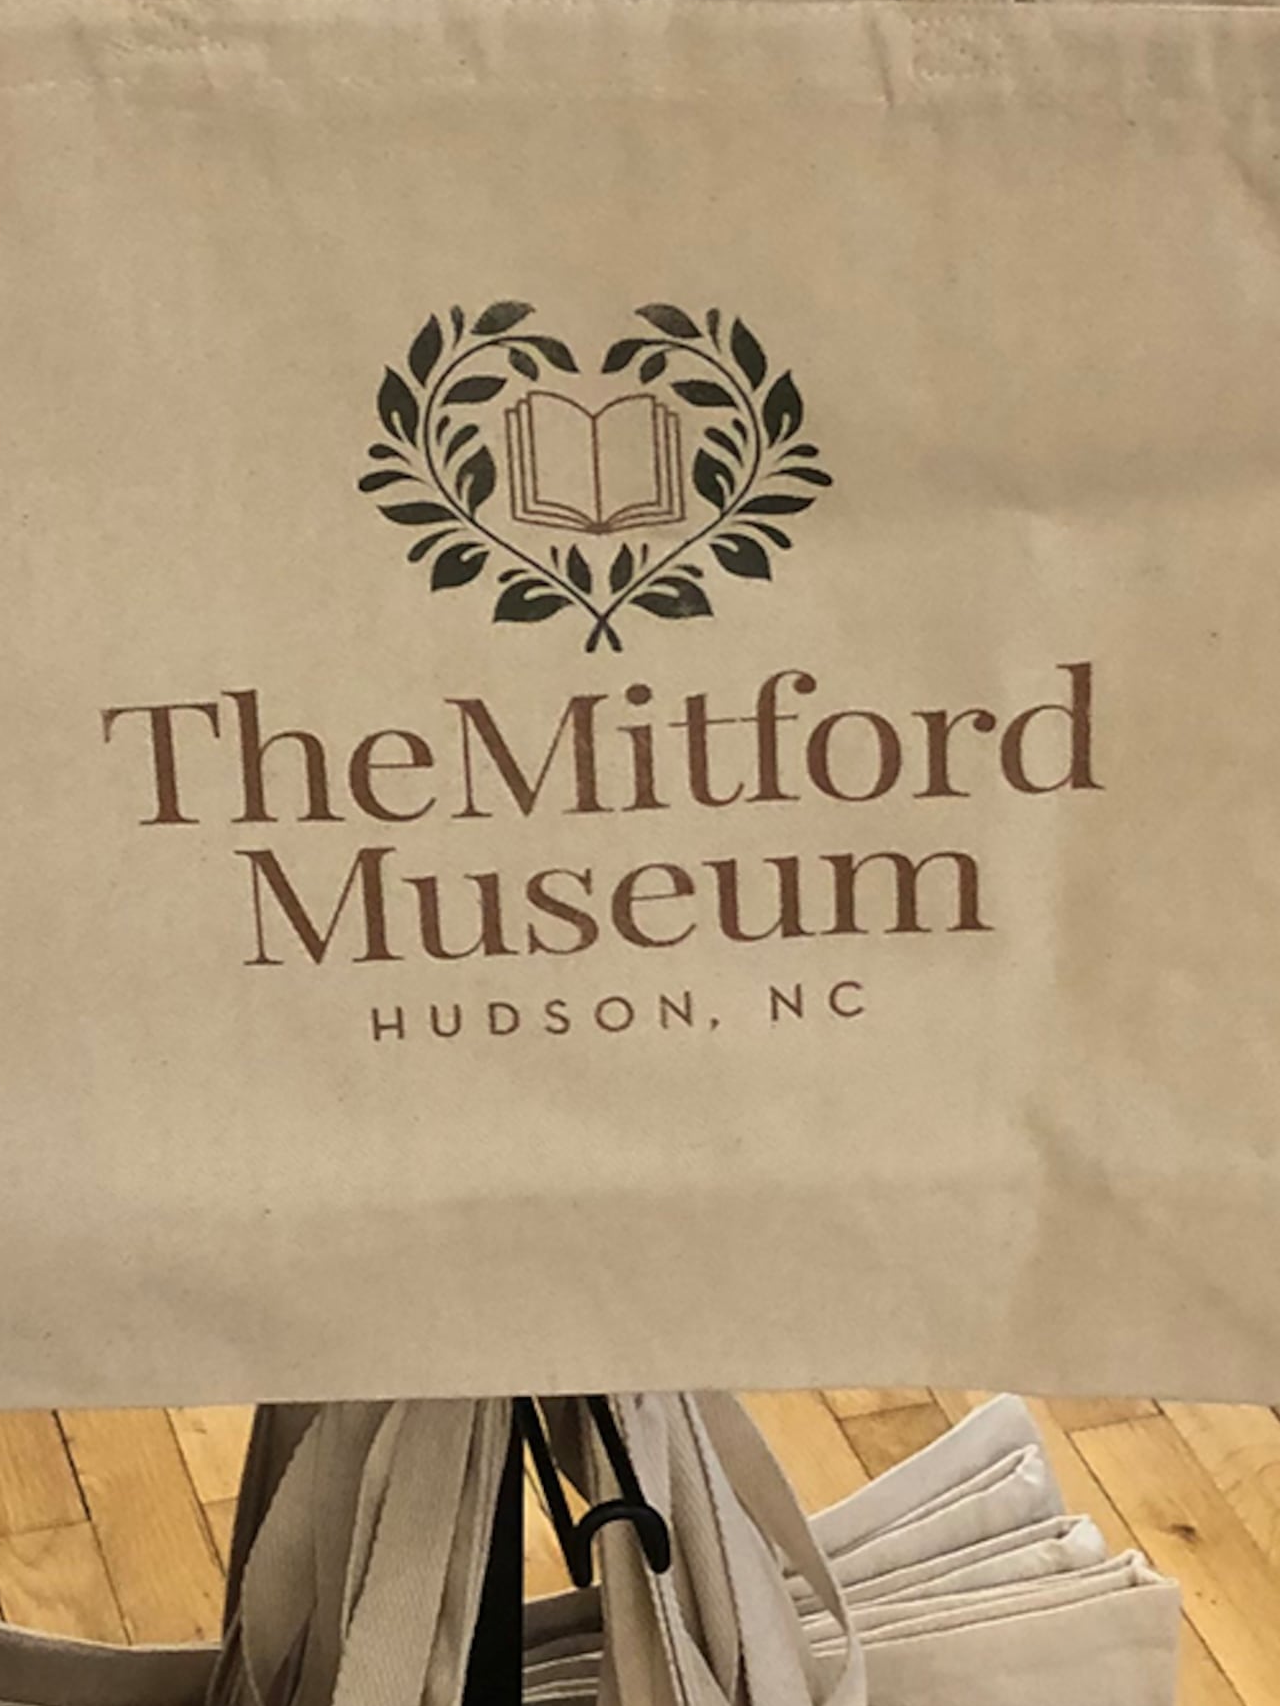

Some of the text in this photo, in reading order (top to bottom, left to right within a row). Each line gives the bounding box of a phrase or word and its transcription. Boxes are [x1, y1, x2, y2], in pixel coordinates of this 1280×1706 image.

[235, 840, 994, 968] Museum
[370, 980, 870, 1043] HUDSON, NC
